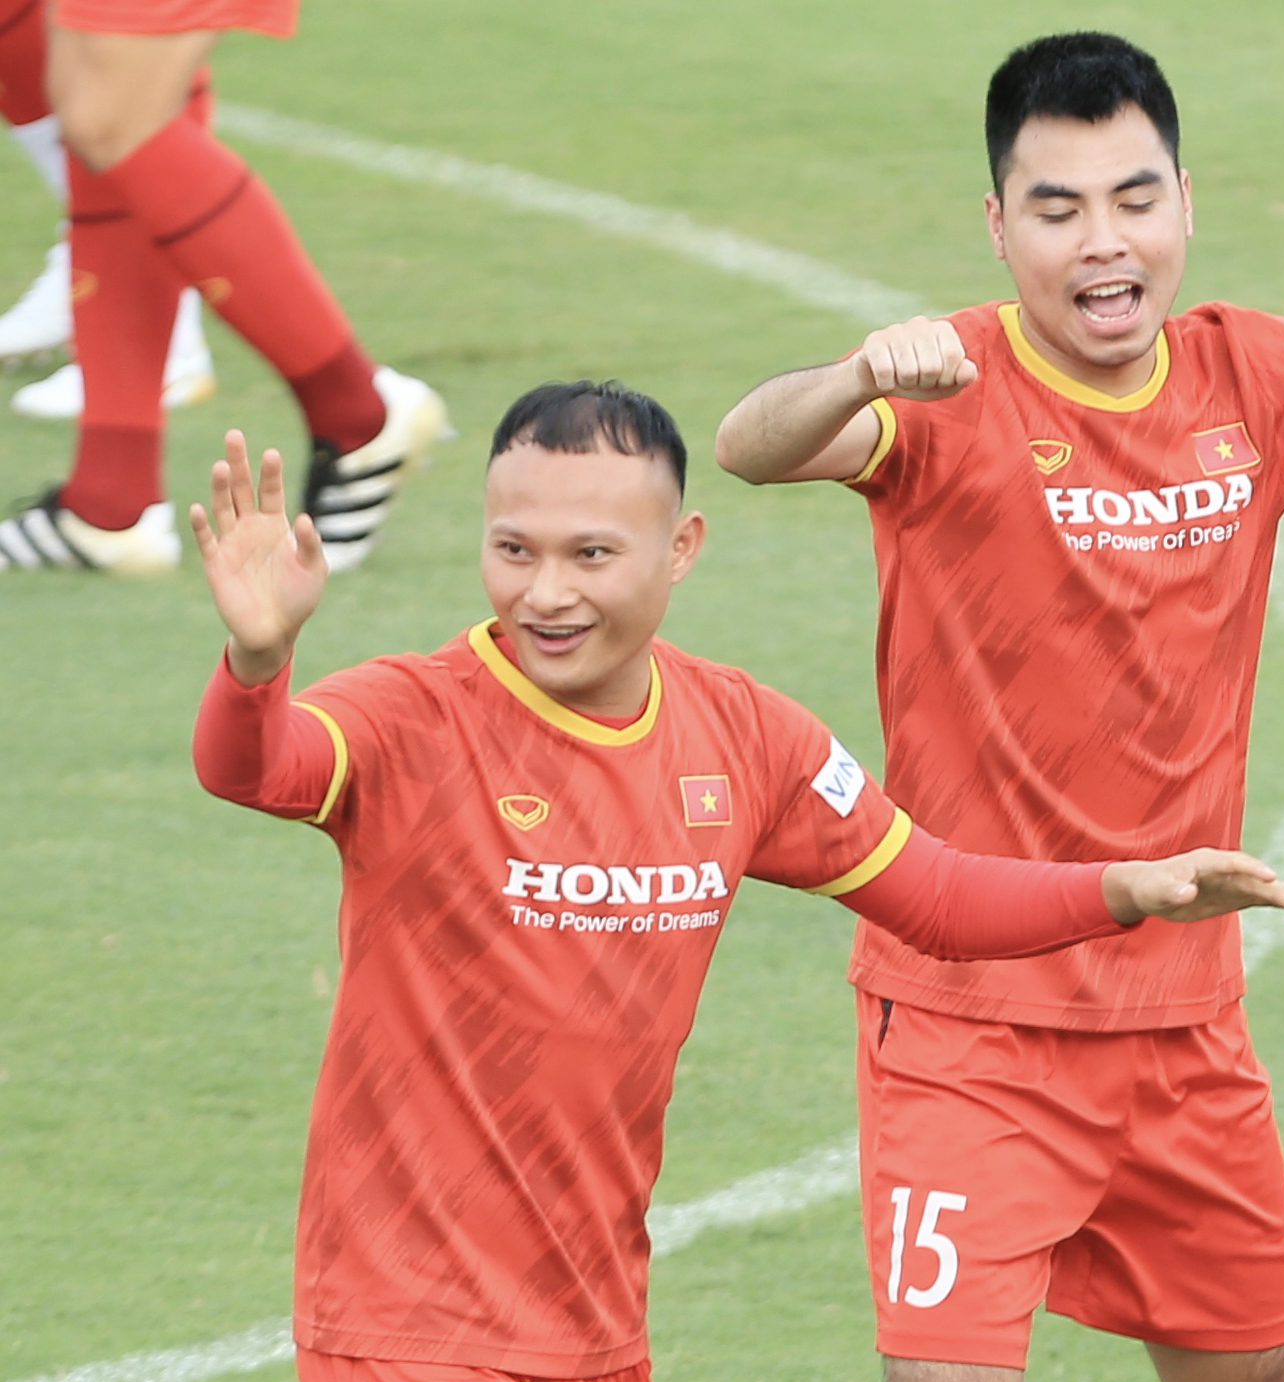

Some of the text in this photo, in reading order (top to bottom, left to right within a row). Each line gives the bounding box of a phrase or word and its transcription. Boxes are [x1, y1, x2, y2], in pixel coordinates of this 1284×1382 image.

[1044, 474, 1252, 526] HONDA
[1062, 532, 1093, 551] he
[1097, 531, 1160, 552] Power
[1163, 529, 1187, 550] of
[502, 858, 729, 905] HONDA
[510, 904, 720, 934] The Power of Dreams
[887, 1186, 968, 1309] 15
